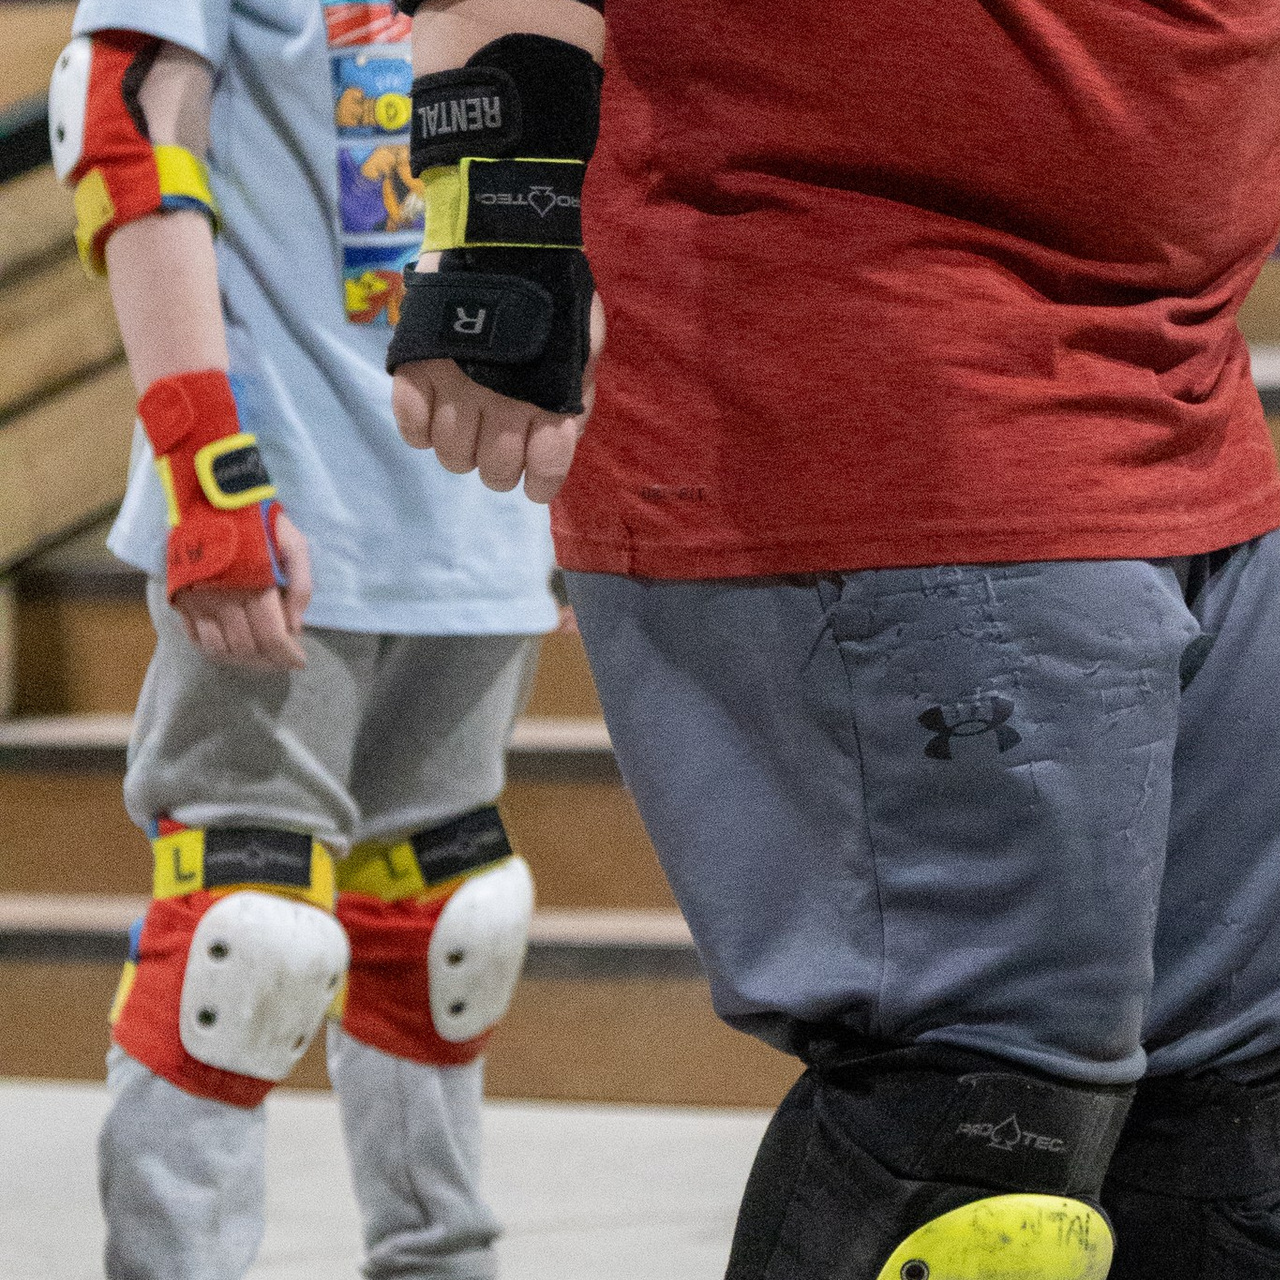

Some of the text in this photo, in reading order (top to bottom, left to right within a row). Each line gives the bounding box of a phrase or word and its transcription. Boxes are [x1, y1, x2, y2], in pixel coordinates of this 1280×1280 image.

[416, 94, 502, 139] RENTAL
[480, 192, 528, 206] TEC
[453, 306, 488, 335] R
[172, 847, 196, 882] L
[1021, 1130, 1064, 1152] TEC
